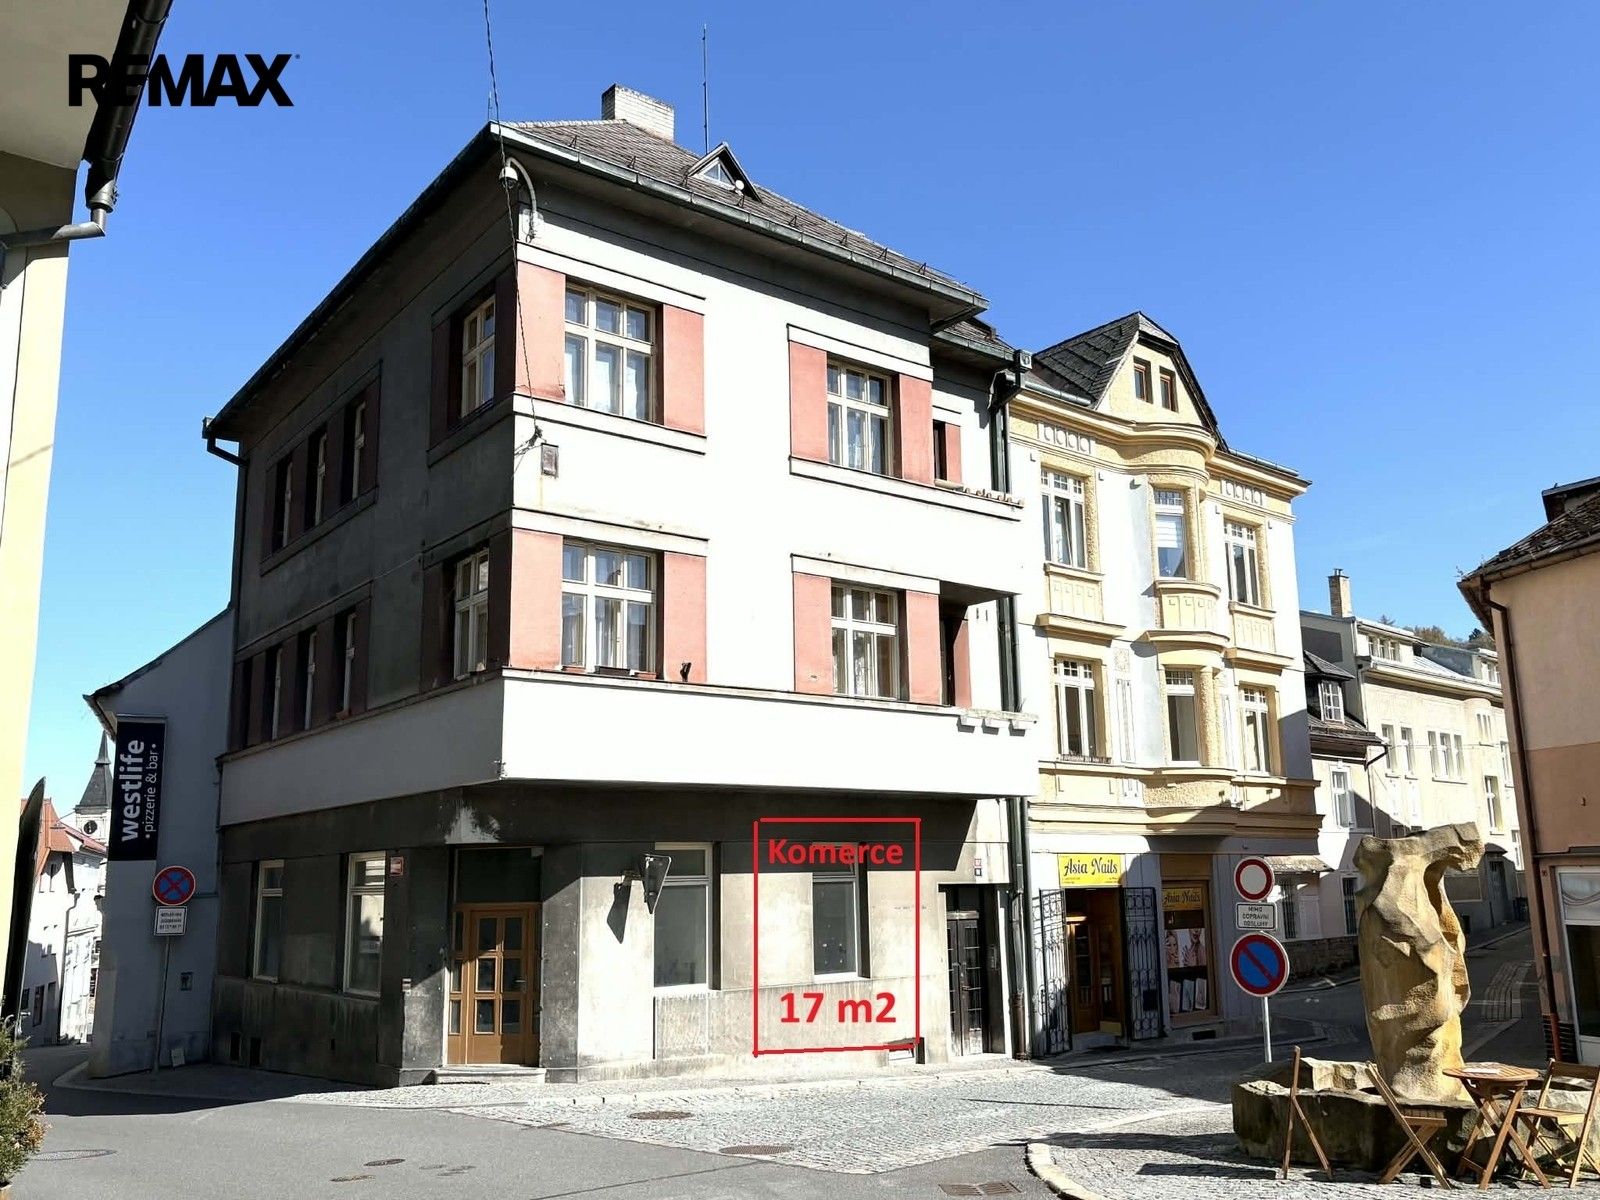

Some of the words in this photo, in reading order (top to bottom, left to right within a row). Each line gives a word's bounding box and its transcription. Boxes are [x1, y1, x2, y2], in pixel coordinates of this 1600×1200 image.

[146, 749, 160, 770] bar
[146, 772, 157, 784] &
[119, 739, 144, 842] westlife
[143, 788, 156, 832] pizzerie
[1063, 858, 1088, 876] Asia
[1091, 857, 1118, 875] Nails
